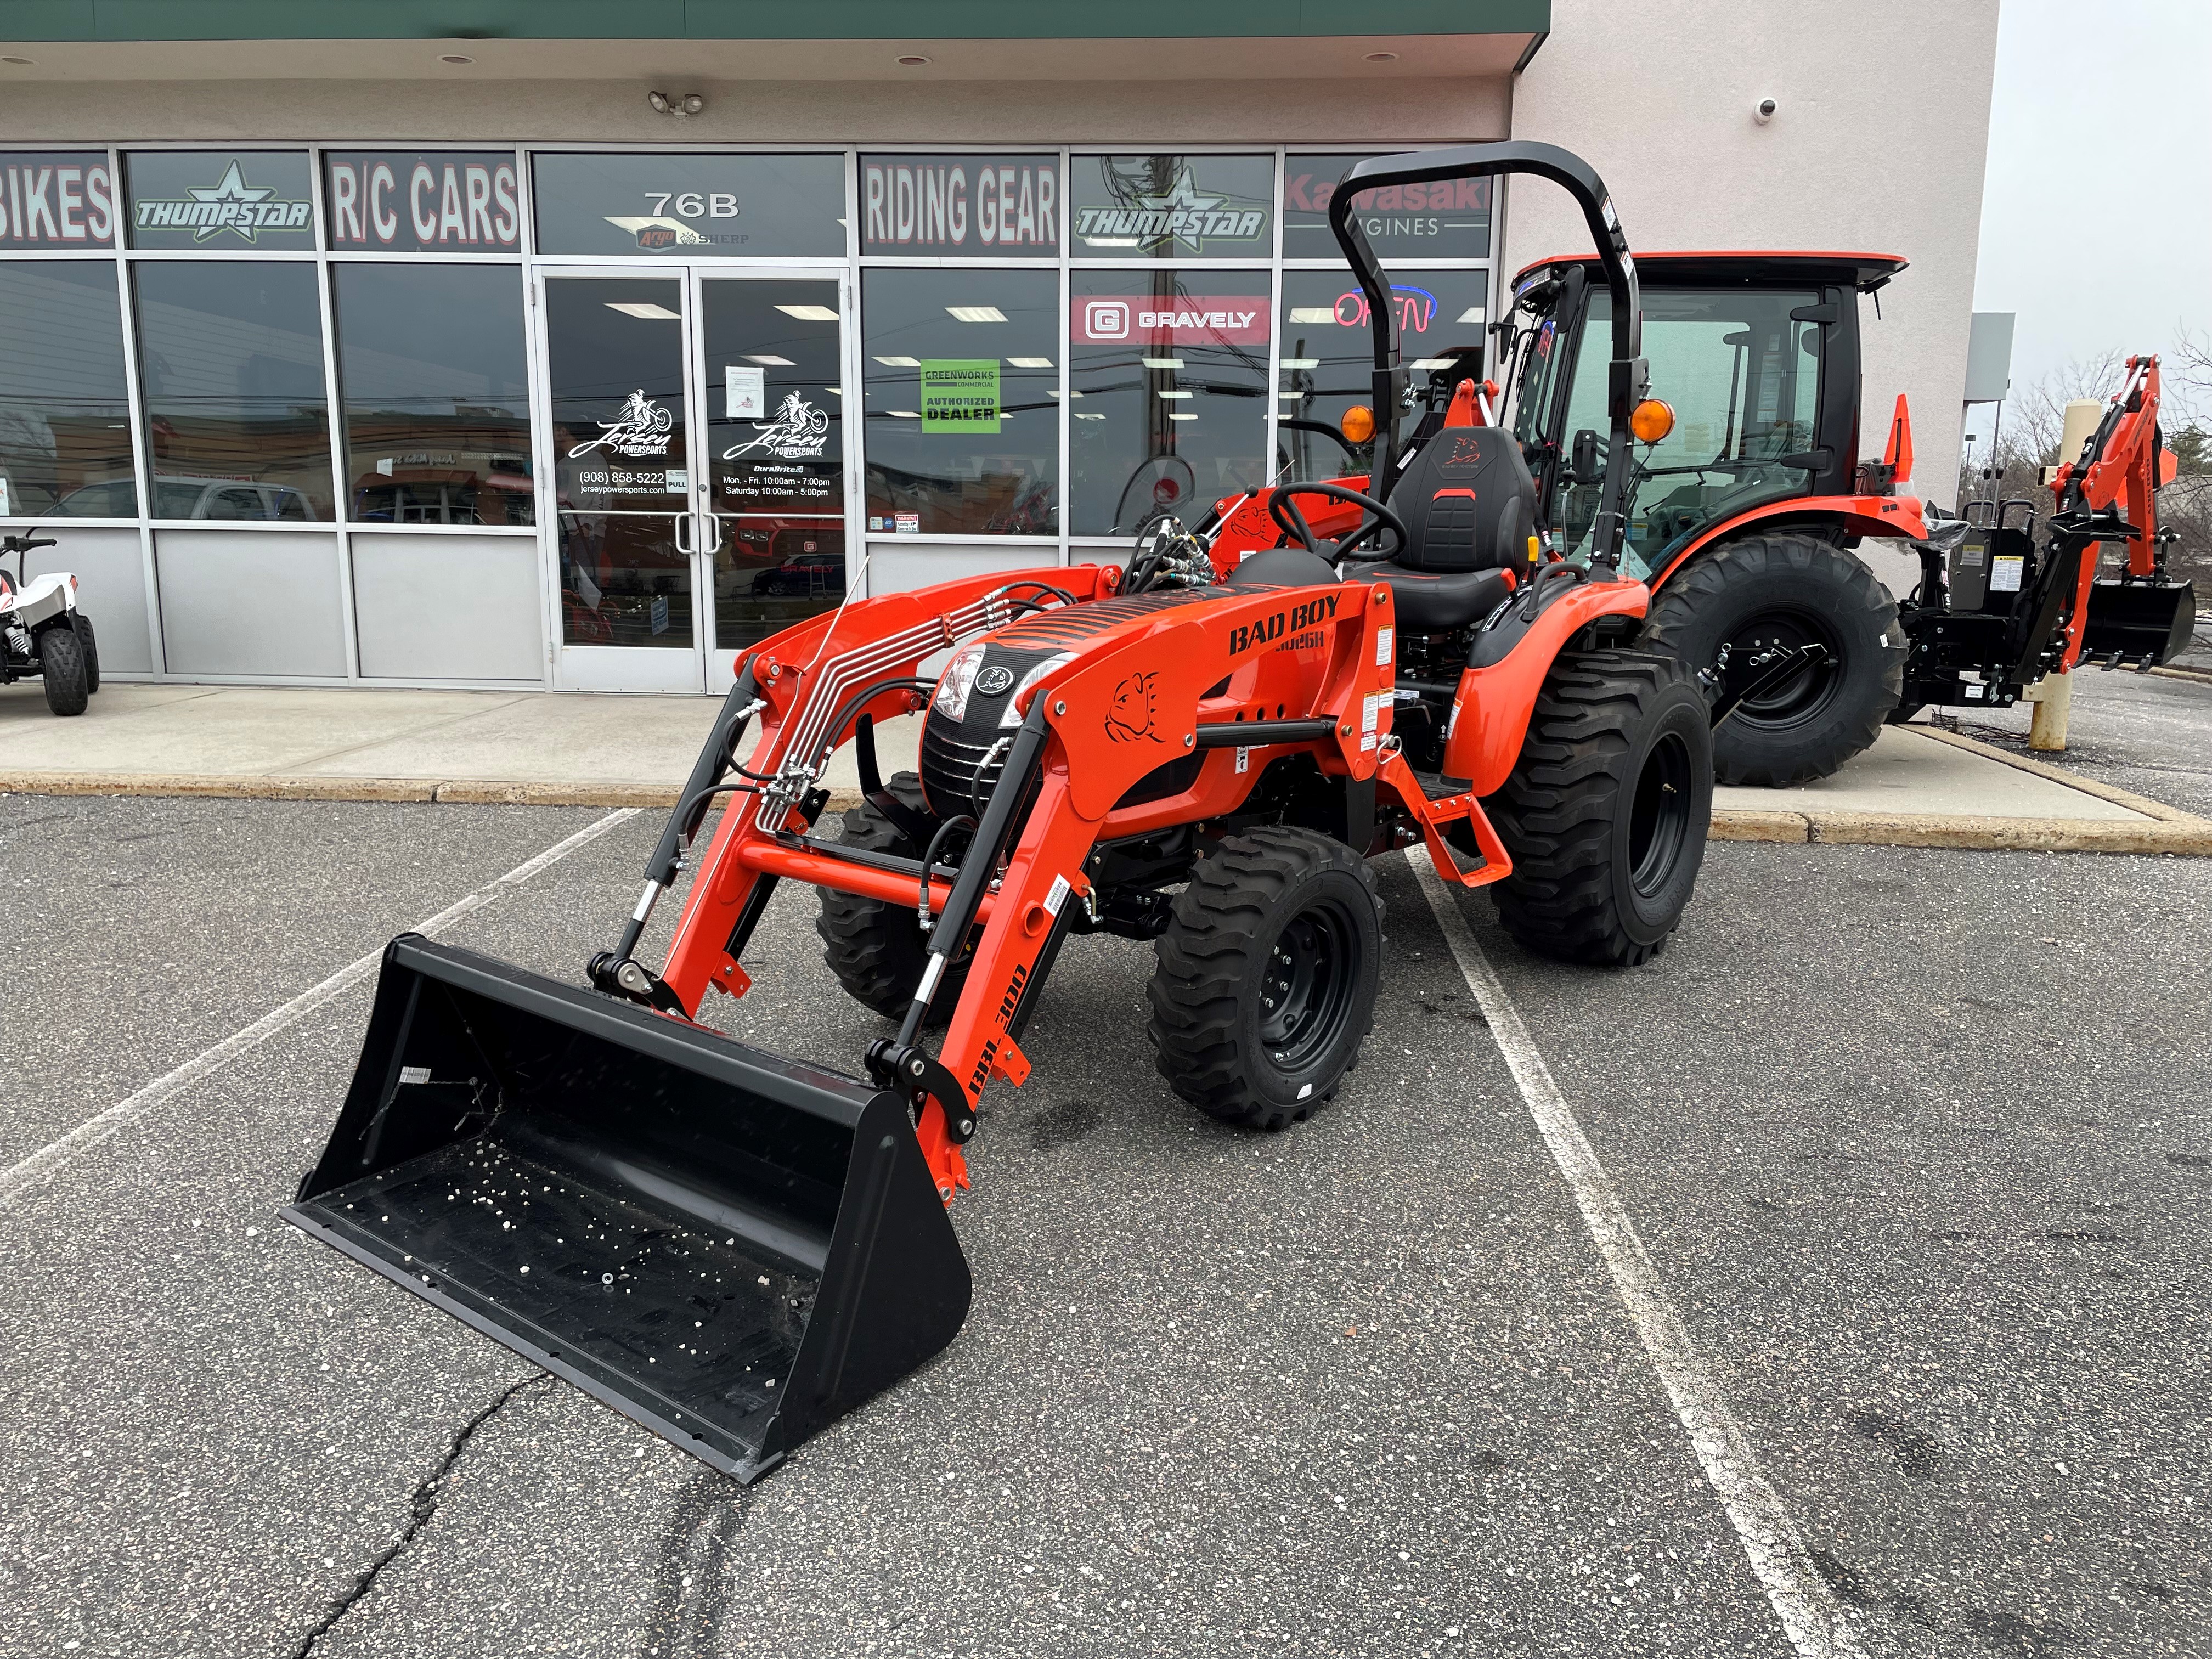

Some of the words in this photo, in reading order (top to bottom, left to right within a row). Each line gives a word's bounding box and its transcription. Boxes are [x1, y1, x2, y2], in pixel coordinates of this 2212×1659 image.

[334, 162, 396, 242] R/C
[410, 163, 519, 244] CARS
[645, 193, 740, 218] 76B
[866, 163, 967, 245] RIDING
[978, 165, 1056, 246] GEAR
[137, 200, 312, 227] THUMPSTAR
[1077, 208, 1263, 238] THUMPSTAR
[1359, 218, 1438, 236] GINES
[640, 231, 675, 246] Argo
[698, 234, 749, 244] SHERP
[1138, 312, 1256, 329] GRAVELY
[926, 371, 994, 380] GREENWORKS
[927, 408, 995, 421] DEALER
[568, 421, 672, 458] Jersey
[723, 422, 827, 460] Jersey
[619, 445, 667, 455] POWERSPORTS
[774, 447, 822, 456] POWERSPORTS
[579, 471, 608, 484] (908)
[612, 472, 665, 484] 858-5222
[723, 476, 742, 484] Mon.
[748, 477, 761, 485] Fri.
[763, 477, 795, 486] 10:00am
[802, 478, 830, 486] 7:00pm
[580, 485, 665, 494] jerseypowersports.com
[725, 487, 759, 496] Saturday
[761, 487, 794, 495] 10:00am
[800, 488, 828, 497] 5:00pm
[1229, 612, 1285, 656] BAD
[1291, 591, 1342, 633] BOY
